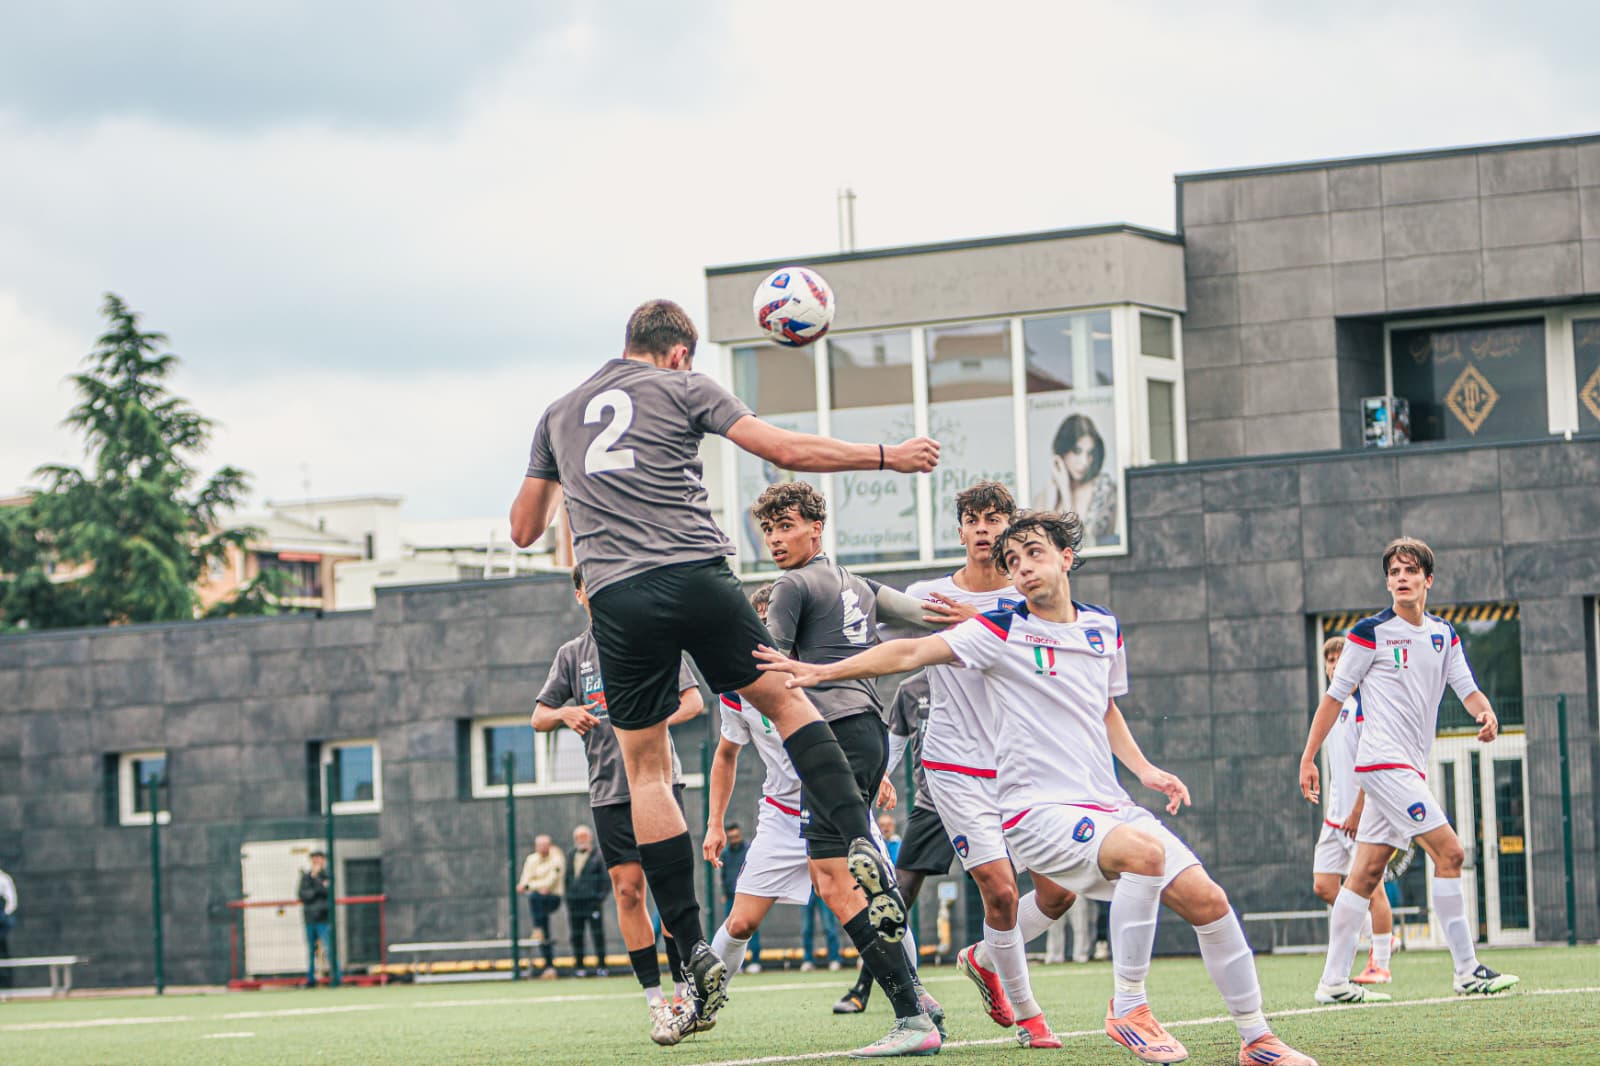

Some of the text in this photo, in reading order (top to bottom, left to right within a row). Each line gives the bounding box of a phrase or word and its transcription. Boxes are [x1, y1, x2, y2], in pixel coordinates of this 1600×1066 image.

[583, 389, 636, 475] 2
[841, 472, 898, 509] Yoga
[841, 588, 868, 644] 6
